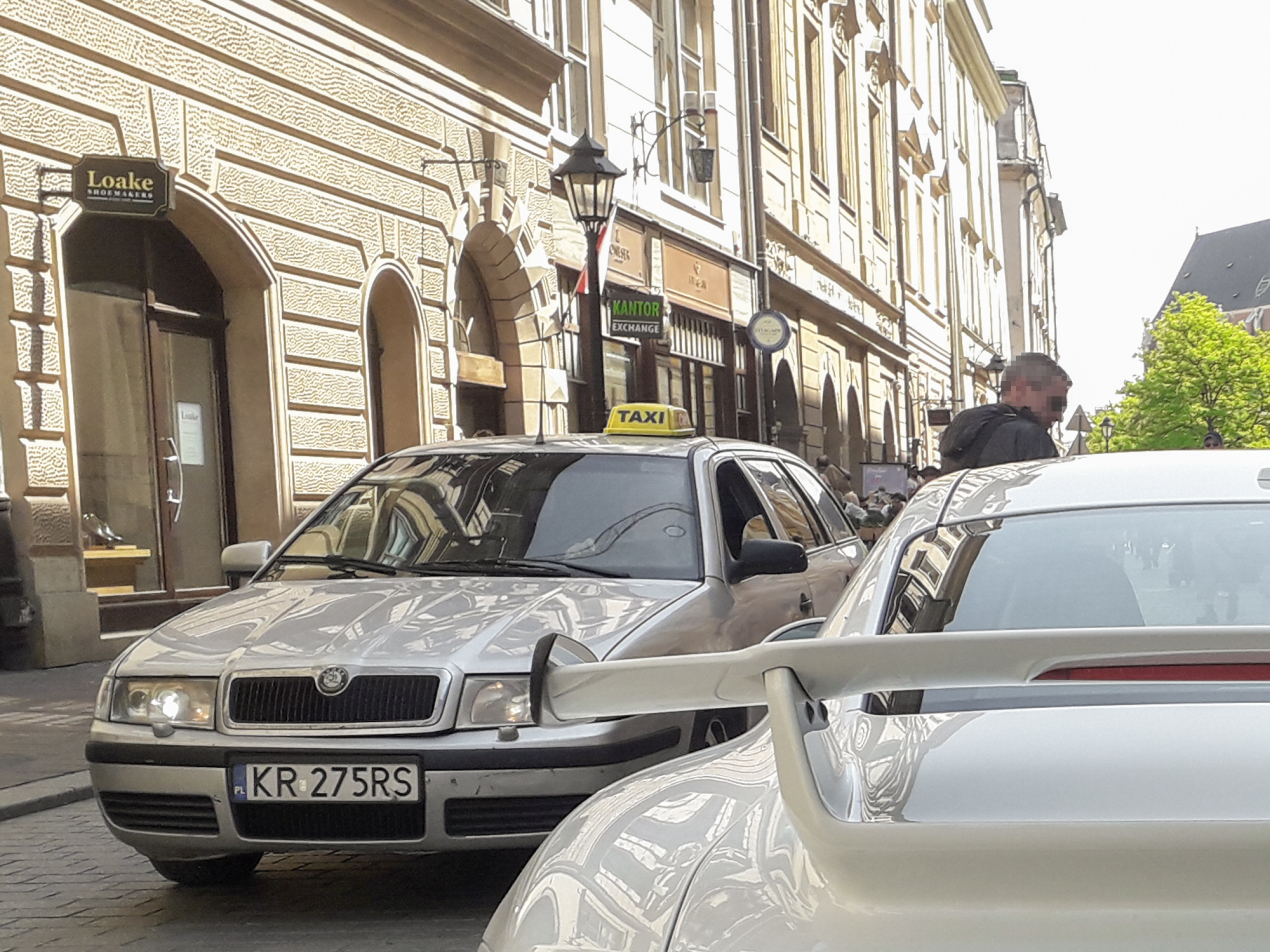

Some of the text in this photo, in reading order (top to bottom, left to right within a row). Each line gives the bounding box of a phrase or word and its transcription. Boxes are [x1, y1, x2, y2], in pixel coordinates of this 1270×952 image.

[87, 170, 154, 191] Loake
[87, 189, 153, 198] SHOEMAKERS
[613, 300, 659, 317] KANTOR
[612, 323, 659, 333] EXCHANGE
[617, 410, 665, 424] TAXI
[253, 766, 412, 796] KR 275RS
[234, 785, 246, 796] PL
